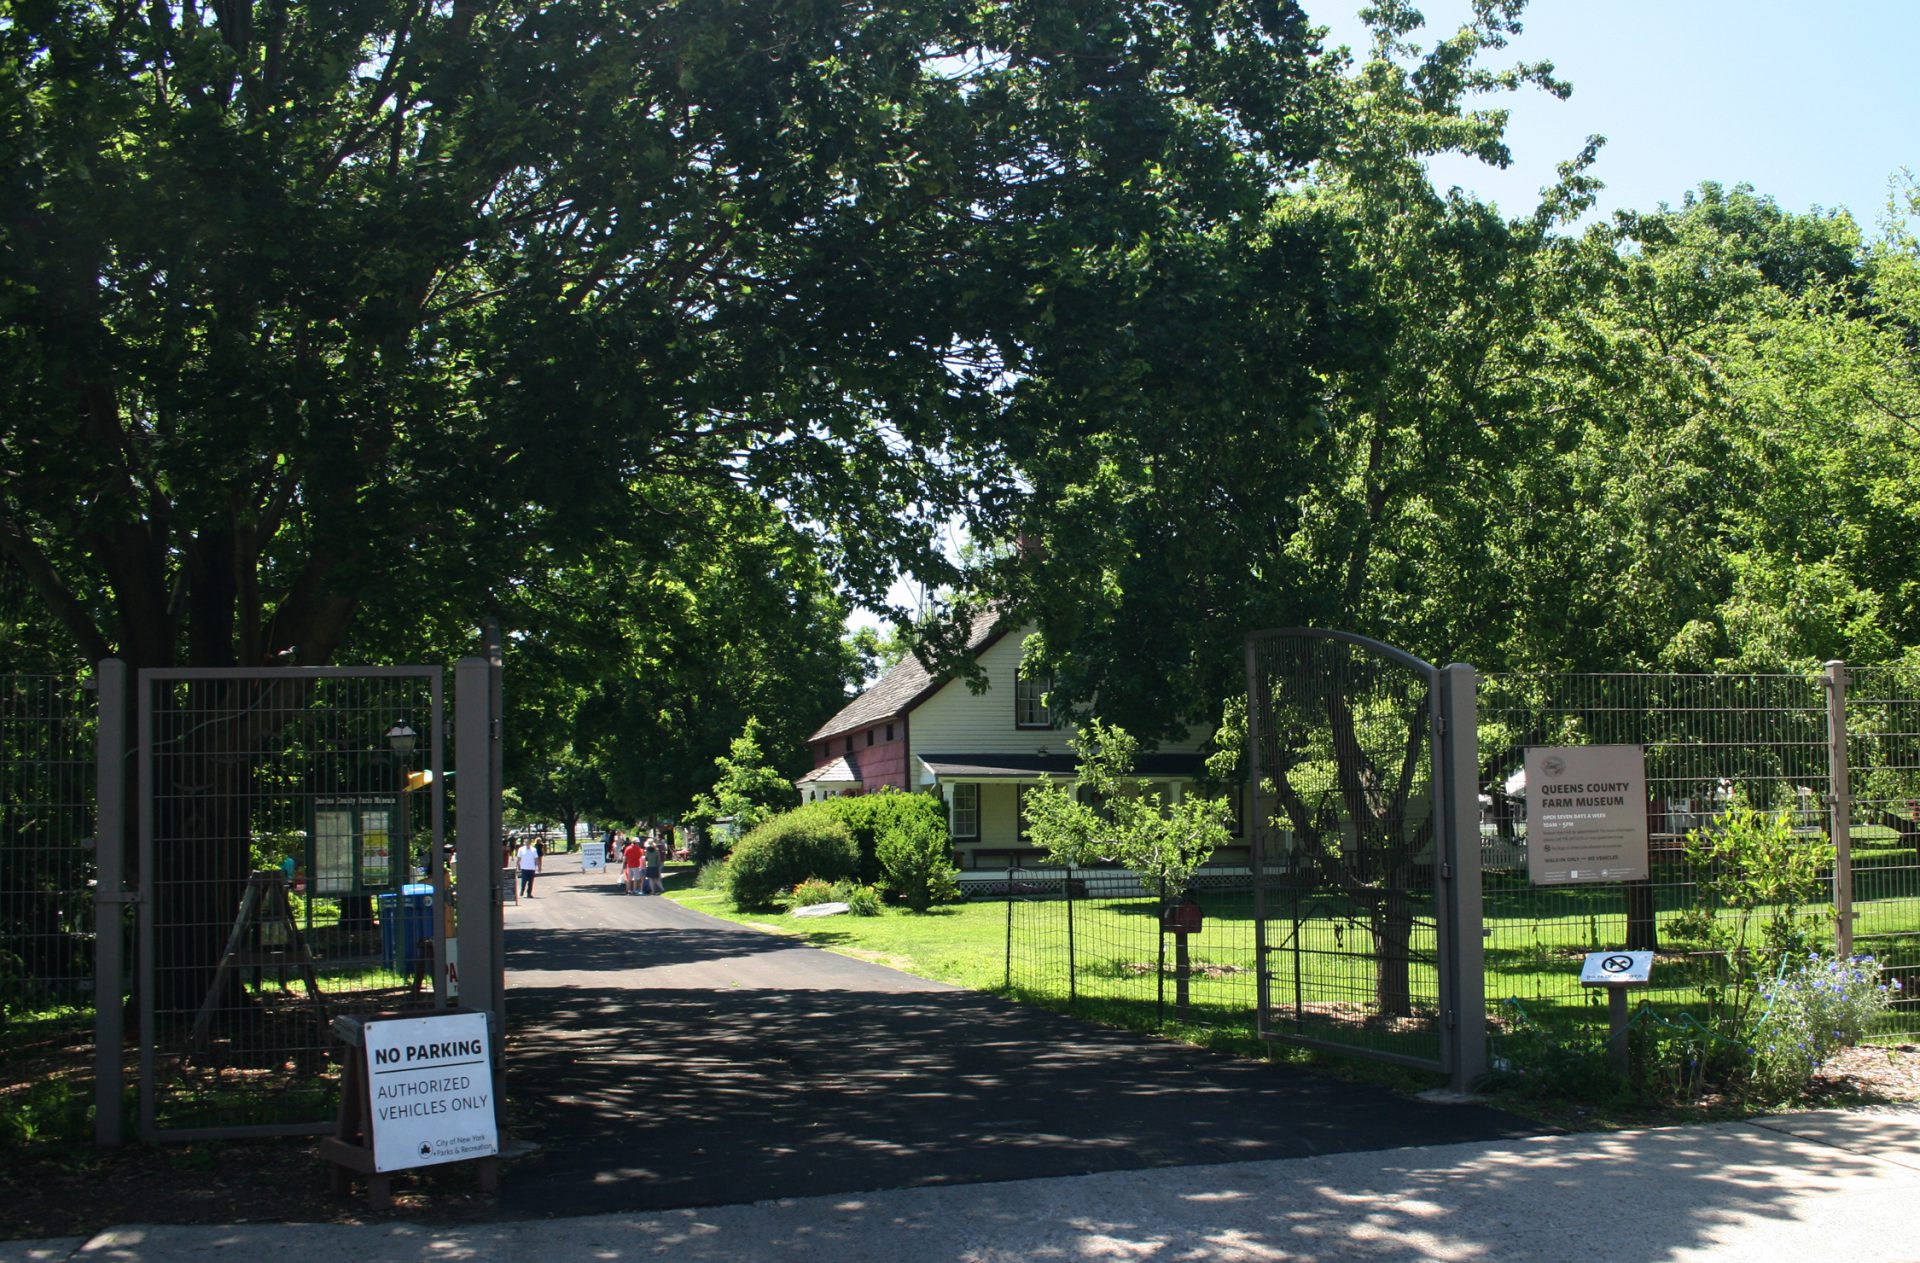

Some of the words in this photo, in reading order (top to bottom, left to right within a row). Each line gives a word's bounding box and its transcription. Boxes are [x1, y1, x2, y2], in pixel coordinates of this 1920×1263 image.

[1541, 783, 1584, 795] QUEENS
[1587, 782, 1630, 793] COUNTY
[336, 797, 356, 806] County
[1542, 798, 1572, 808] FARM
[1576, 796, 1624, 807] MUSEUM
[1562, 821, 1574, 829] 5PM
[375, 1047, 401, 1065] NO
[406, 1039, 482, 1061] PARKING
[377, 1076, 470, 1099] AUTHORIZED
[379, 1099, 447, 1120] VEHICLES
[452, 1095, 488, 1111] ONLY
[436, 1139, 449, 1148] City
[449, 1137, 456, 1146] of
[457, 1136, 471, 1145] New
[472, 1134, 485, 1143] York
[436, 1148, 453, 1157] Parks
[461, 1143, 492, 1154] Recreation
